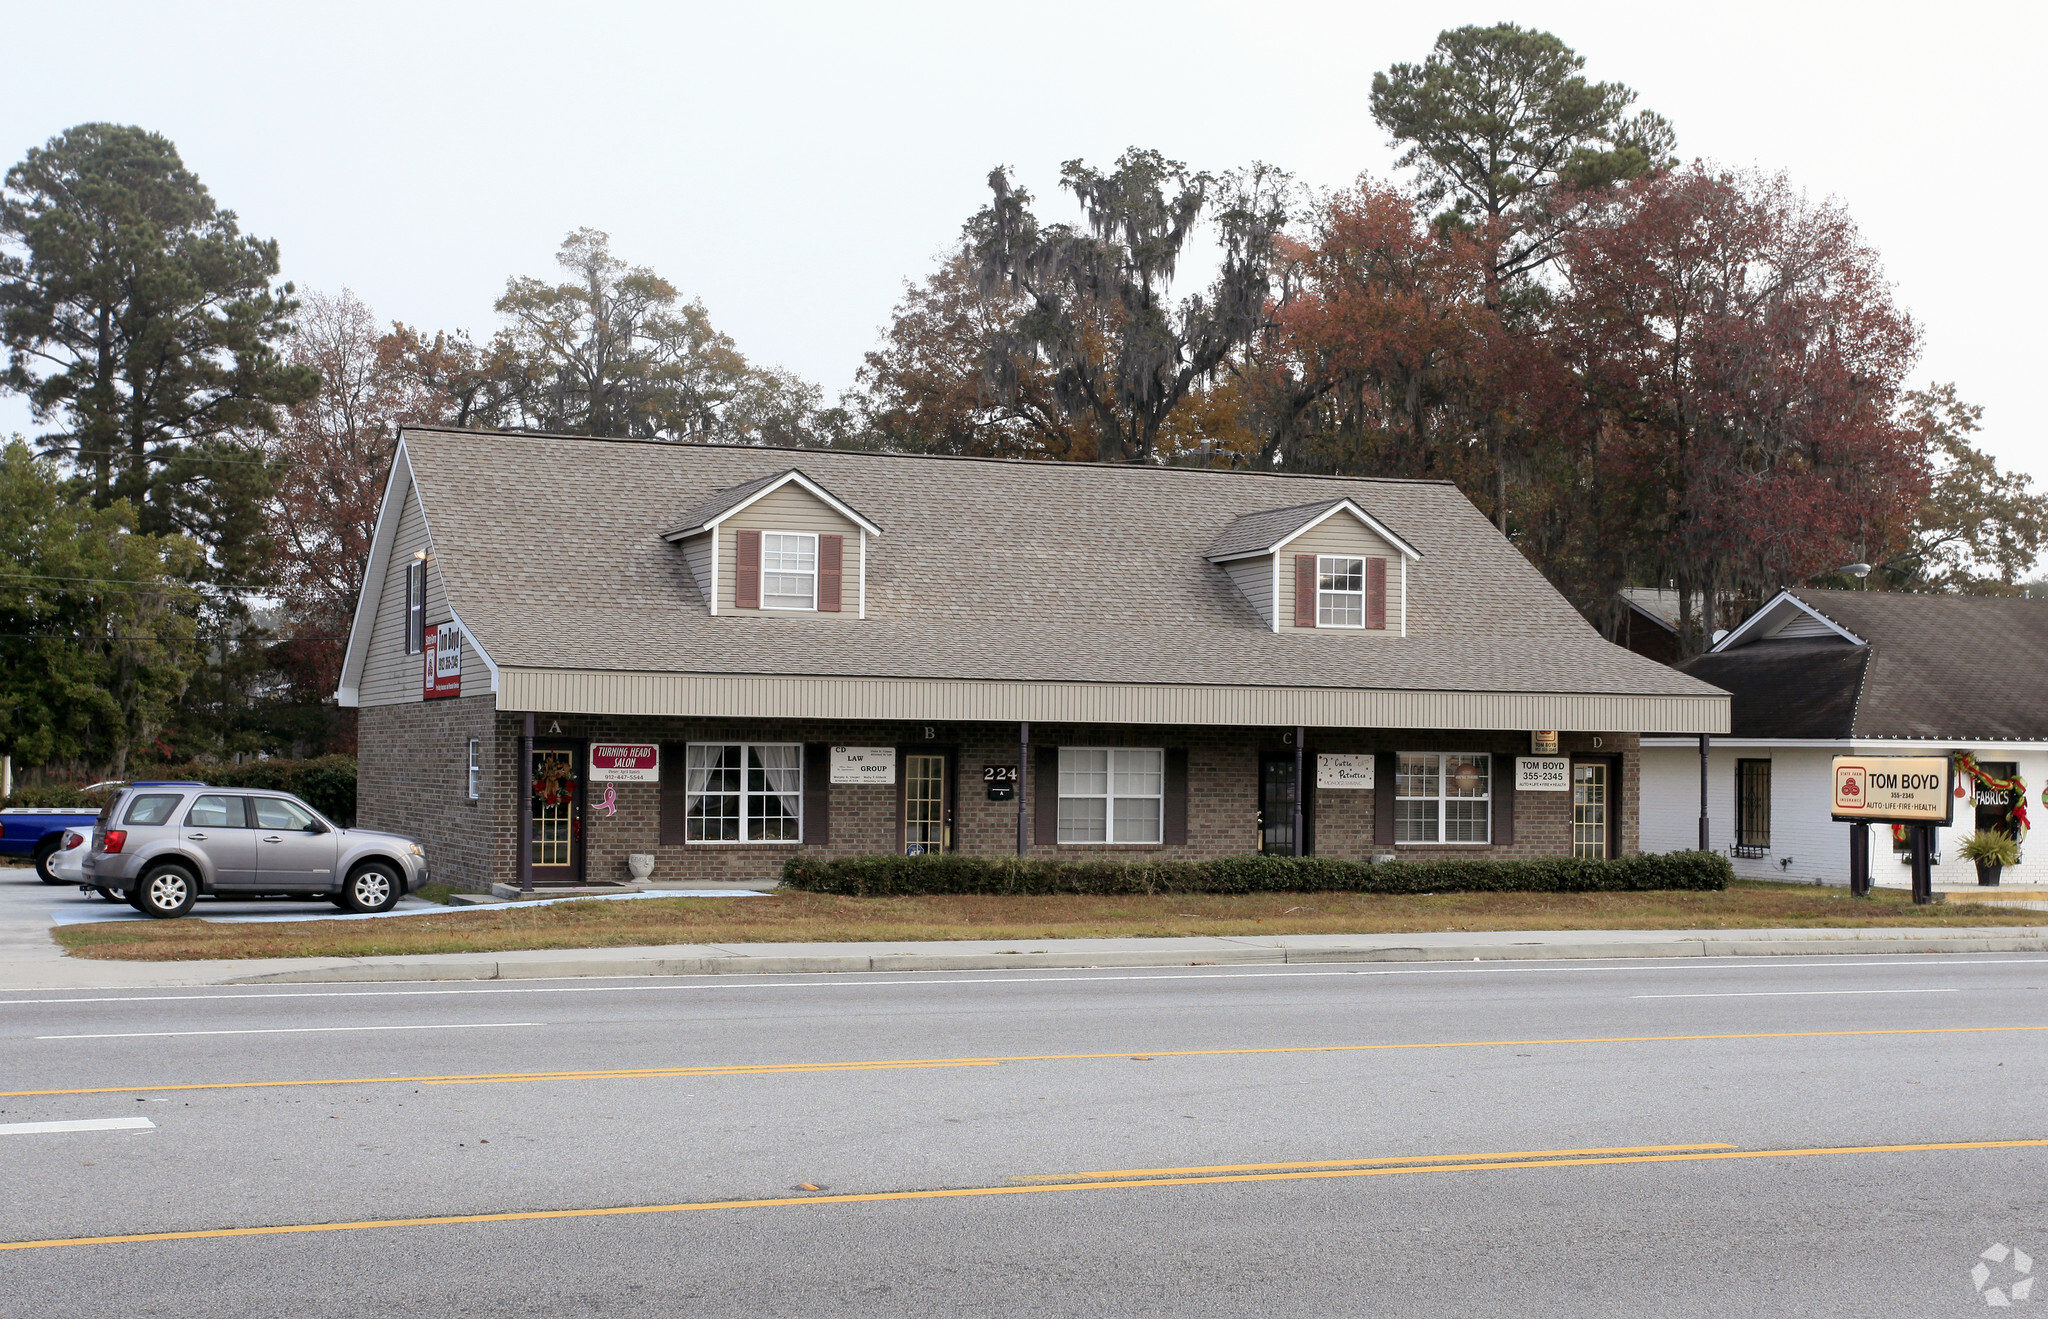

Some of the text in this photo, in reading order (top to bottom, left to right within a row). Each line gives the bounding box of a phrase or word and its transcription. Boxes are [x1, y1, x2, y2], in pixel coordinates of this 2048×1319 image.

[548, 720, 562, 733] A
[924, 727, 935, 739] B
[1283, 732, 1292, 744] C
[1593, 737, 1602, 748] D
[598, 747, 652, 757] TURNING HEADS
[614, 758, 636, 768] SALON
[1323, 758, 1352, 766] 2 Cutie
[984, 768, 1017, 780] 224
[1523, 772, 1563, 780] 355-2345
[1869, 774, 1939, 789] TOM BOYD
[1976, 791, 2009, 805] FABRICS
